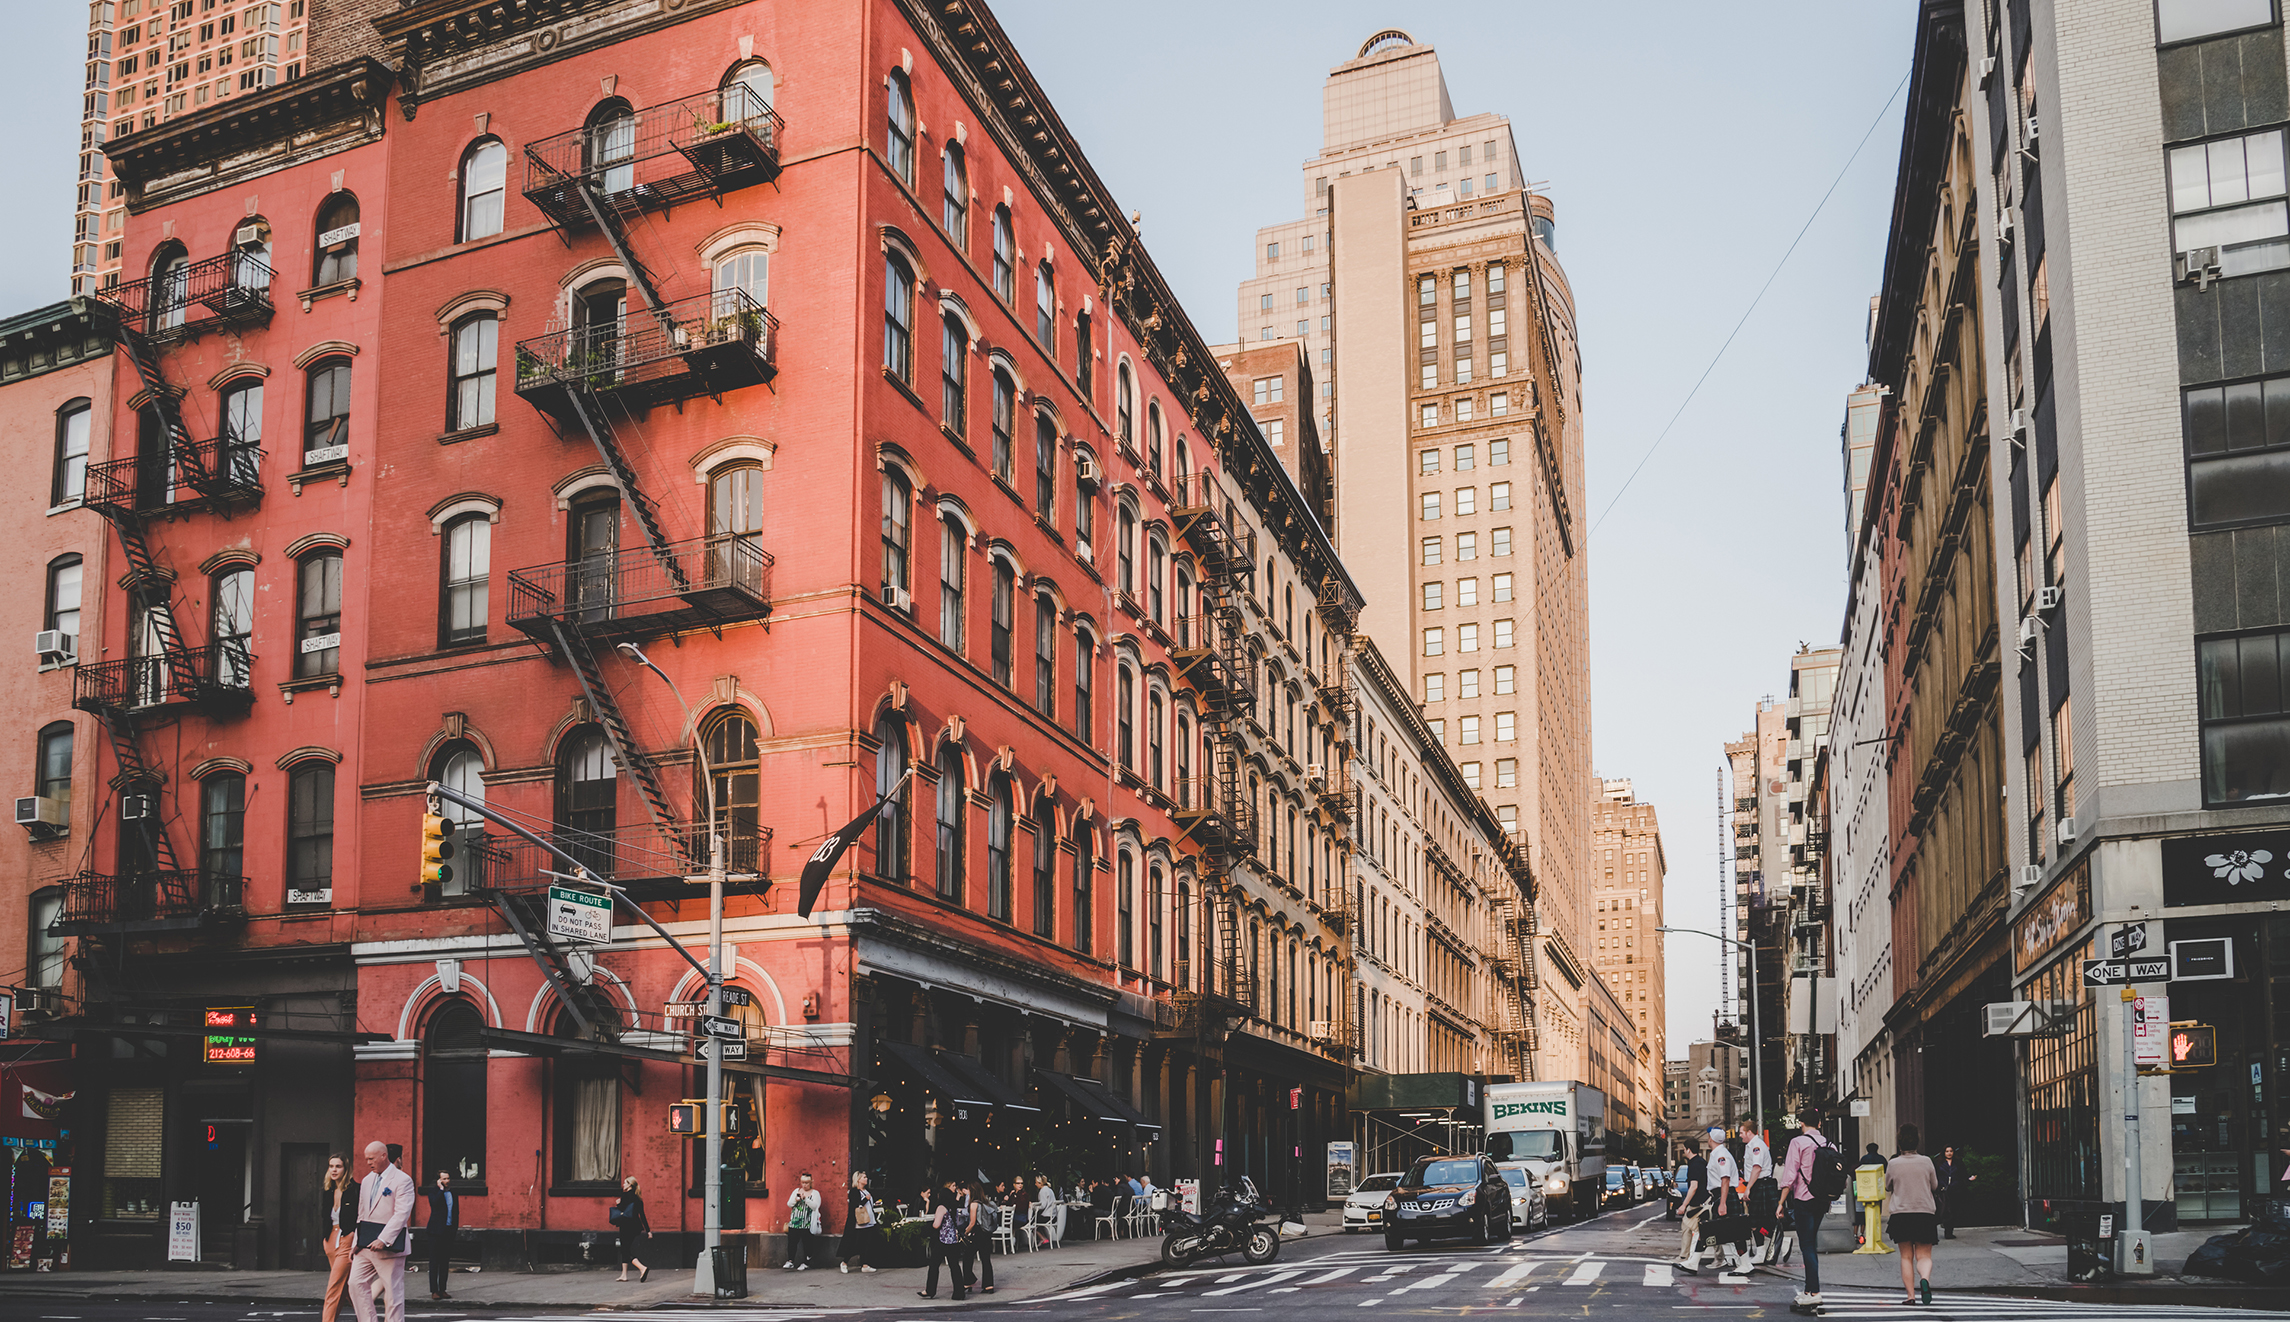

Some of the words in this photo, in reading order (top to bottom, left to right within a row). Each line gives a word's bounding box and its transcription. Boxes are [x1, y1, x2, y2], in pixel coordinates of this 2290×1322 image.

[323, 225, 357, 245] SHAFTWAY
[310, 446, 343, 463] SHAFTWAY
[305, 635, 340, 651] SHAFTWAY
[560, 890, 576, 901] BIKE
[580, 895, 603, 907] ROUTE
[558, 915, 568, 924] DO
[570, 918, 583, 927] NOT
[585, 921, 602, 931] PASS
[560, 926, 588, 937] SHARED
[590, 931, 607, 940] LANE
[2113, 937, 2125, 950] ONE
[2131, 931, 2142, 945] WAY
[2092, 966, 2121, 979] ONE
[2136, 963, 2164, 976] WAY
[722, 990, 739, 1004] READE
[741, 993, 748, 1005] ST
[664, 1004, 695, 1017] CHURCH
[697, 1004, 707, 1016] ST
[707, 1021, 719, 1031] ONE
[724, 1024, 735, 1033] WAY
[724, 1046, 740, 1054] WAY
[2253, 1066, 2260, 1079] A
[1492, 1101, 1567, 1120] BEKINS
[175, 1221, 191, 1231] $50
